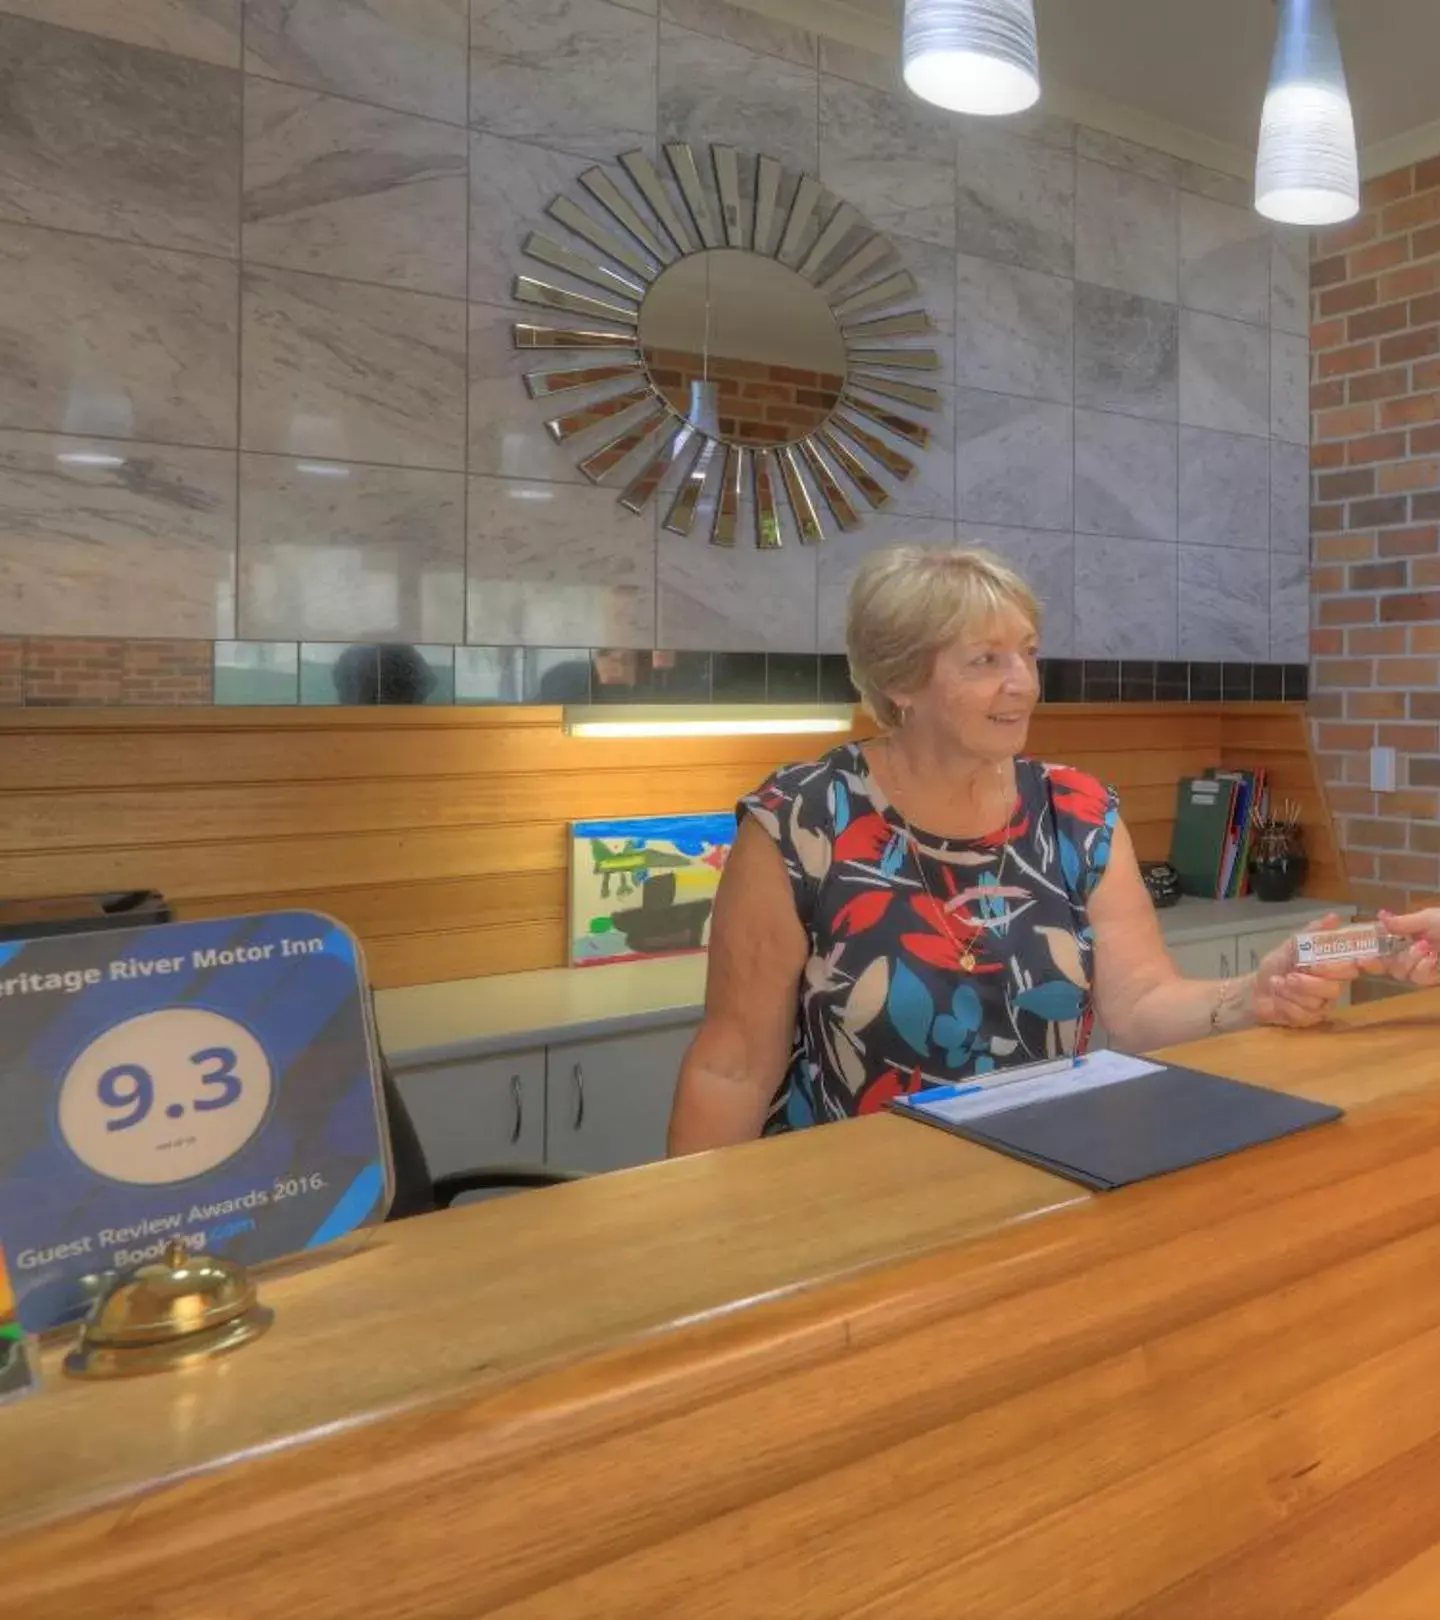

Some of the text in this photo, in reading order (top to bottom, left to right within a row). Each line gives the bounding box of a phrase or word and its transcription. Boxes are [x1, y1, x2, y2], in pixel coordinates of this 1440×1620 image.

[0, 936, 324, 997] ritage River Motor Inn
[97, 1046, 243, 1132] 9.3
[16, 1235, 94, 1270] Guest
[98, 1212, 182, 1248] Review
[187, 1187, 268, 1224] Awards
